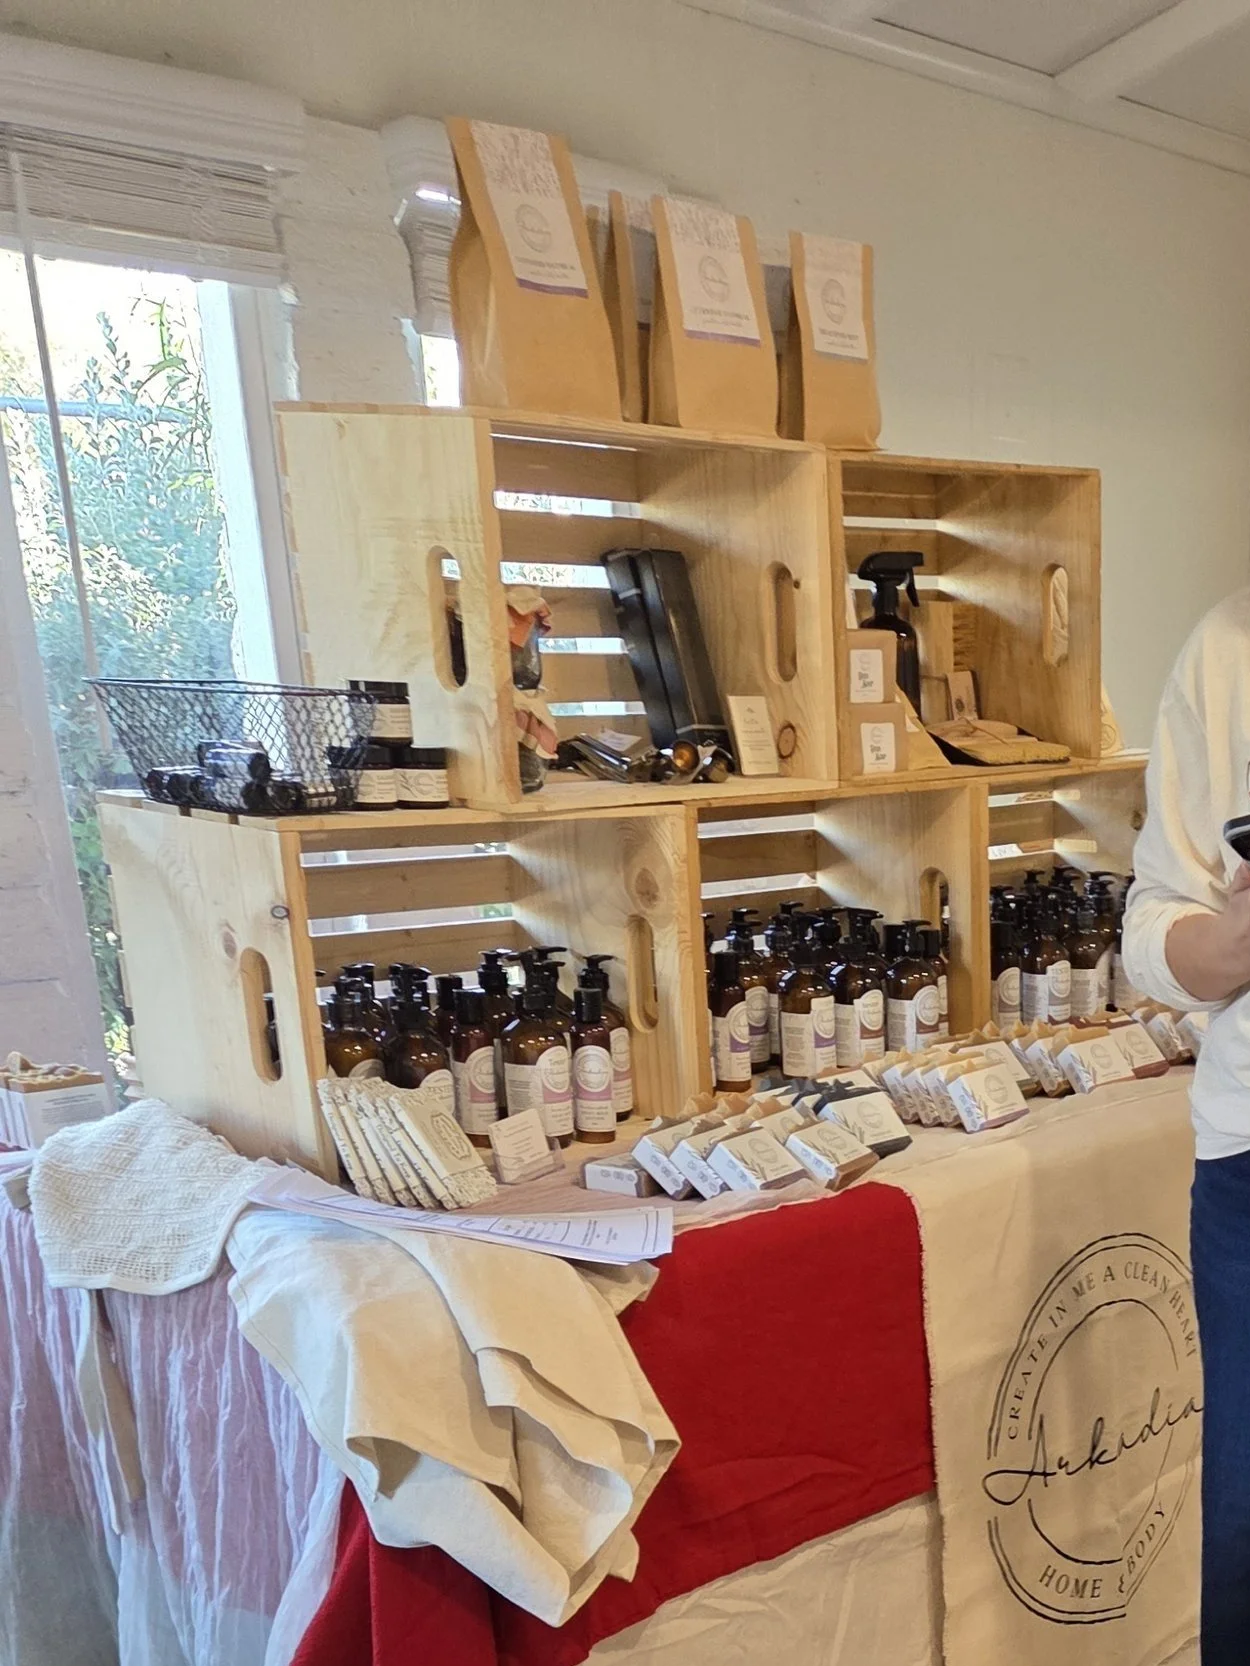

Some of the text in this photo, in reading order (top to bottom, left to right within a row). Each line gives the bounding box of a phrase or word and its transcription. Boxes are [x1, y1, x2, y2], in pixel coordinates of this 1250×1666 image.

[1008, 1261, 1198, 1440] CREATE IN ME A CLEAN HEART
[982, 1386, 1204, 1506] Arkadia
[1039, 1564, 1104, 1600] HOME
[1126, 1501, 1166, 1575] BODY
